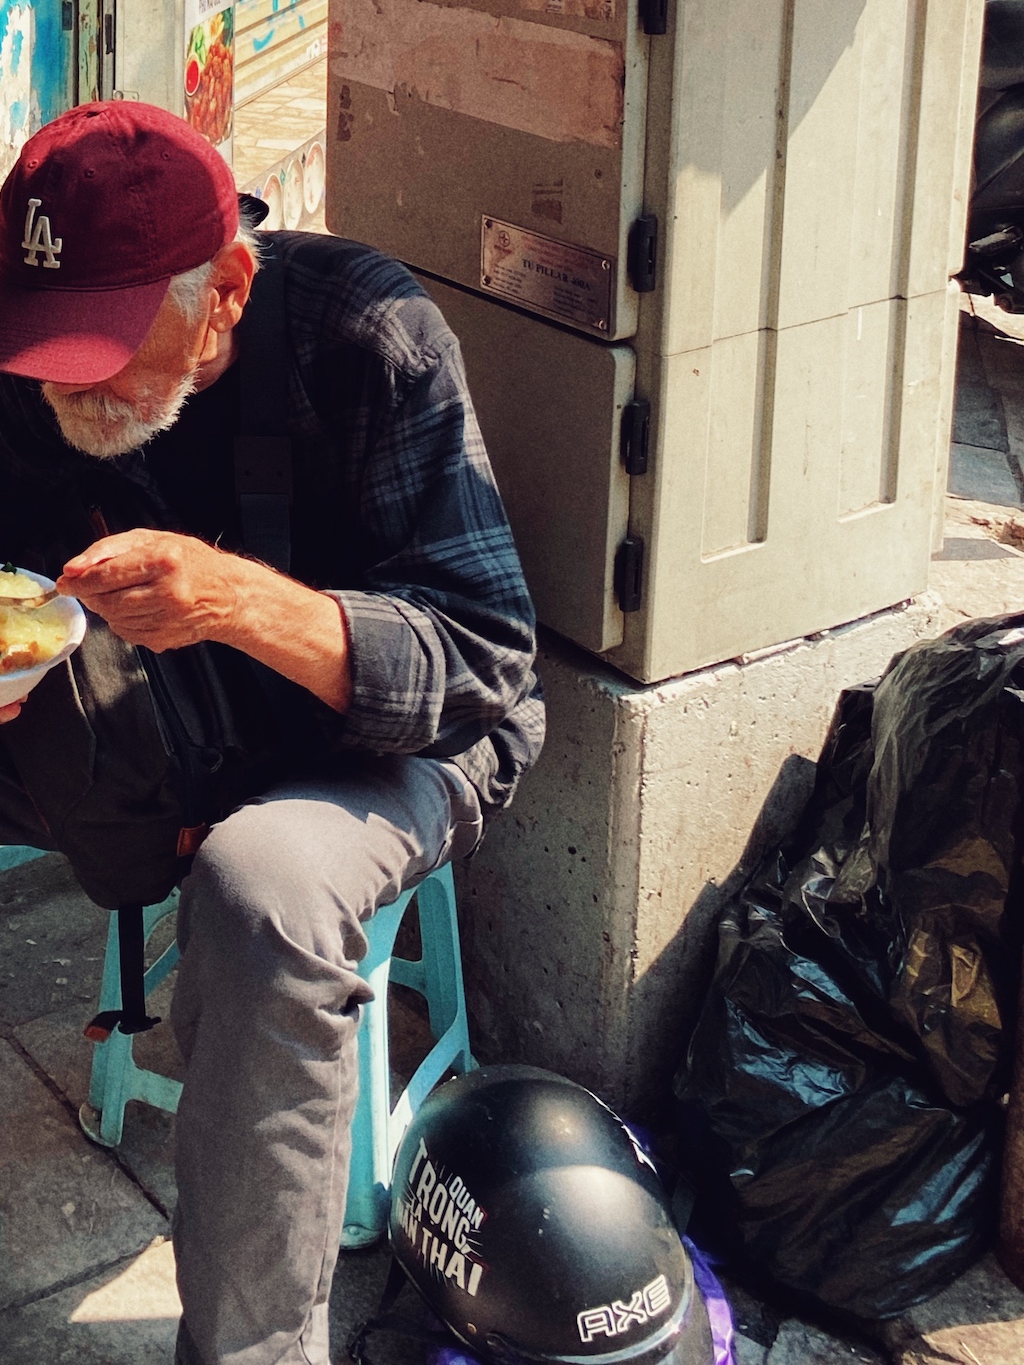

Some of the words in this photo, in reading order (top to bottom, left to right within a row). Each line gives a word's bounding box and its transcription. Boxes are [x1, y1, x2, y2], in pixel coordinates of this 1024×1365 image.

[21, 197, 63, 269] LA
[409, 1136, 471, 1250] TRỌNG
[448, 1175, 485, 1230] QUAN
[576, 1273, 671, 1343] AXE
